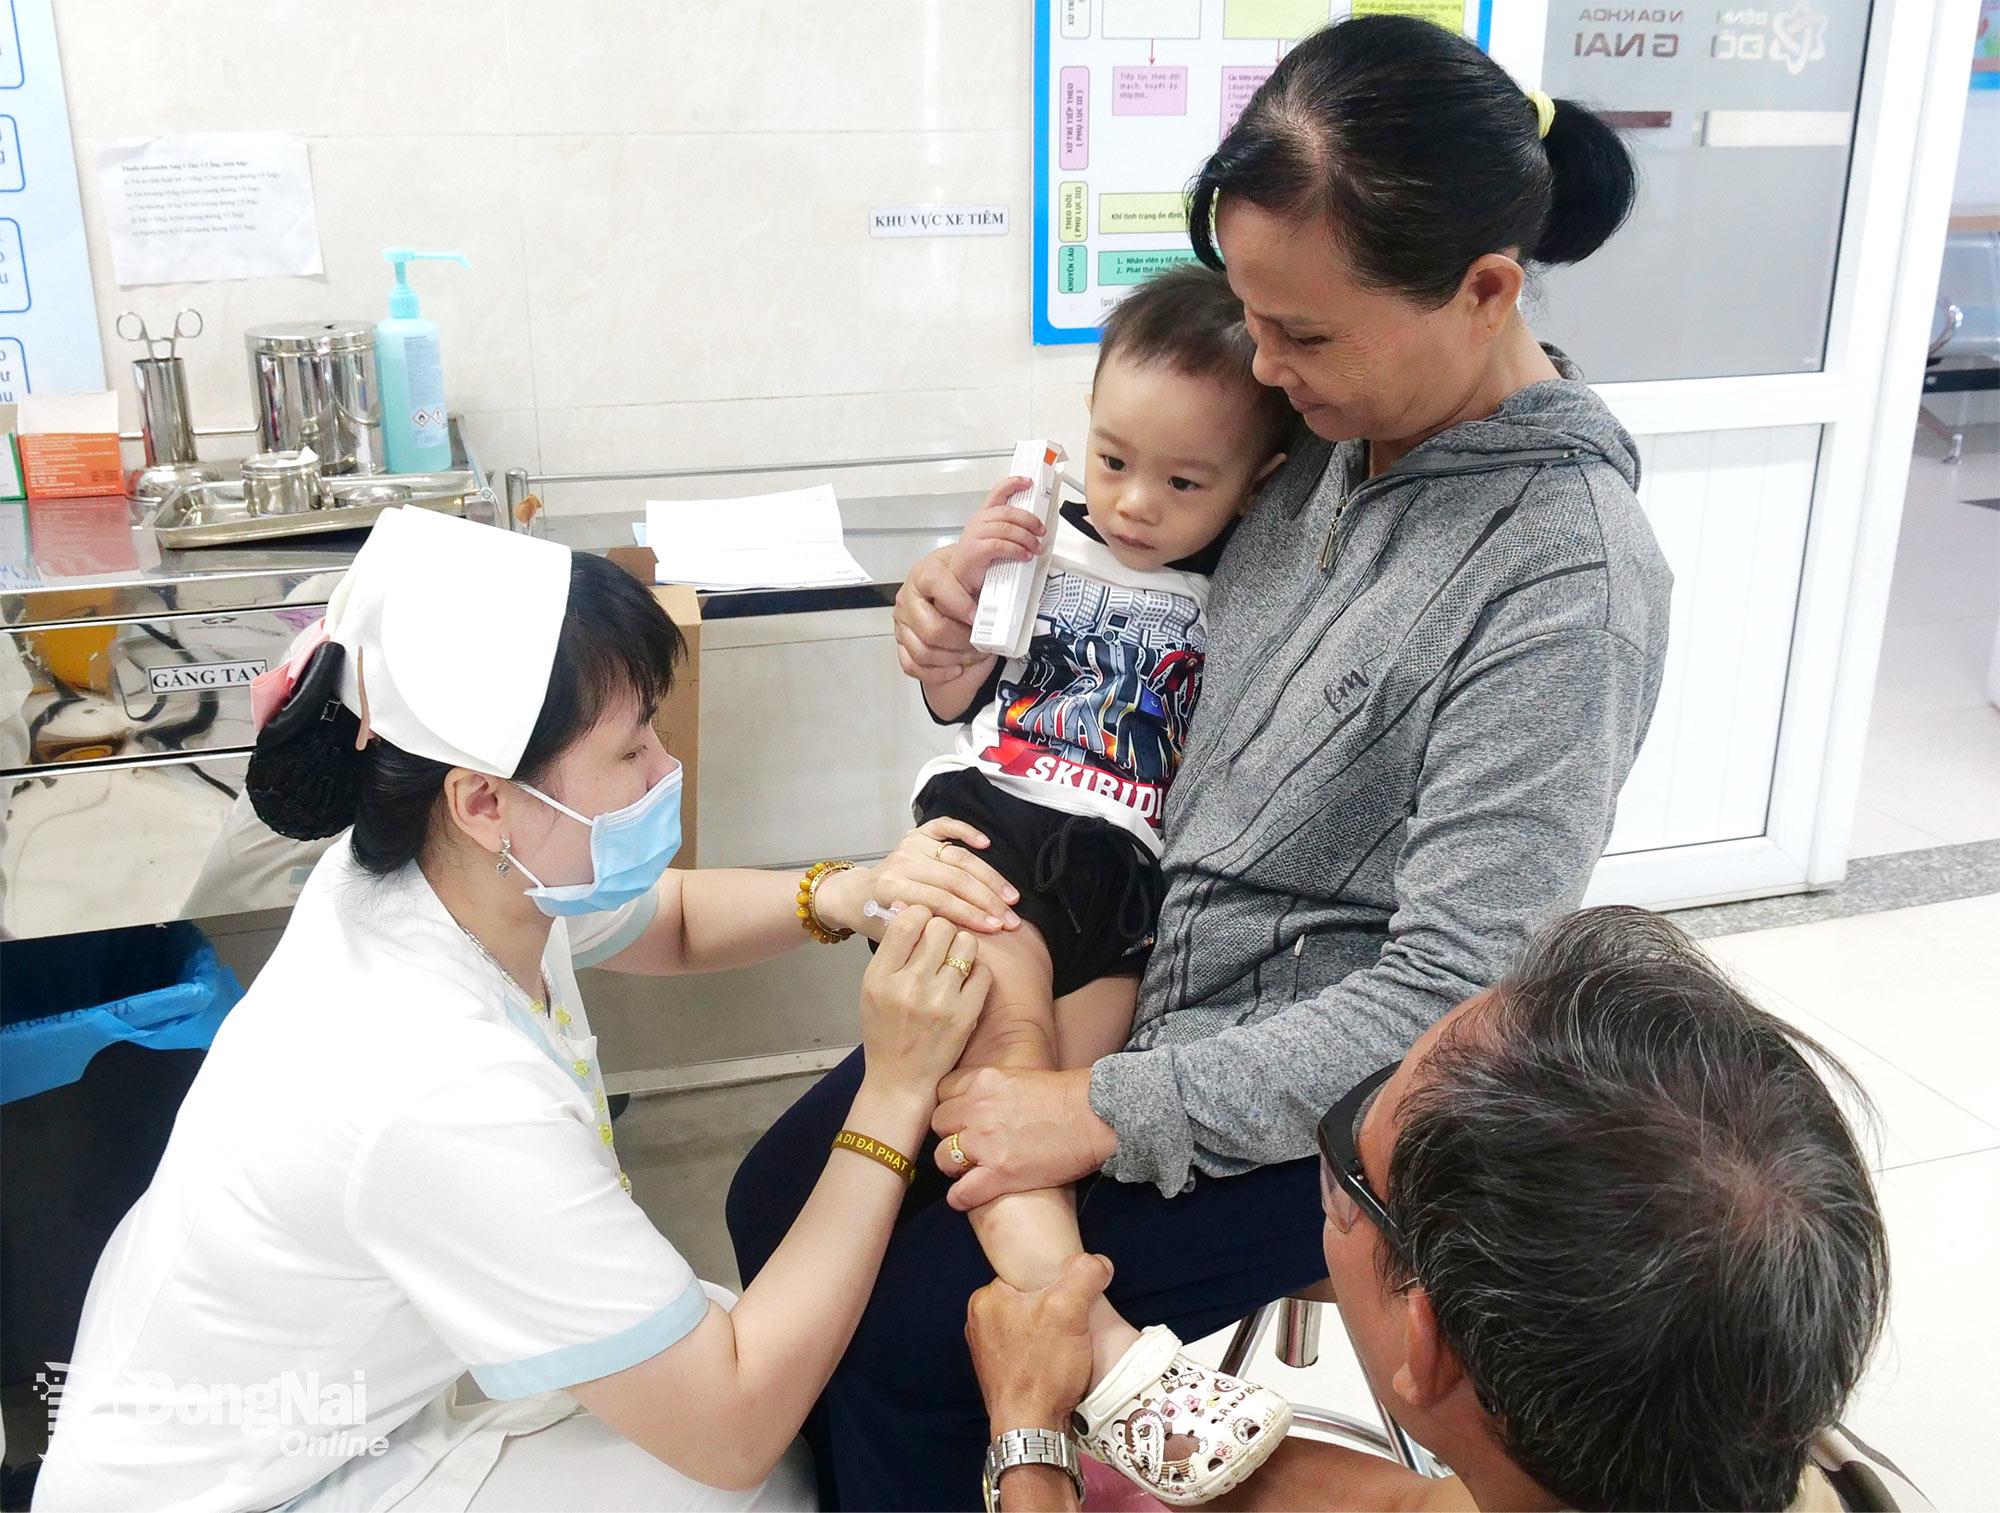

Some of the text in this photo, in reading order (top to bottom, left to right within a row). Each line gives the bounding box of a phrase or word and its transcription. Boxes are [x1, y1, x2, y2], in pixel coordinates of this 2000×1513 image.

[875, 210, 1004, 229] KHU VỰC XE TIÊM
[152, 664, 266, 688] GĂNG TAY
[843, 1134, 856, 1146] DI
